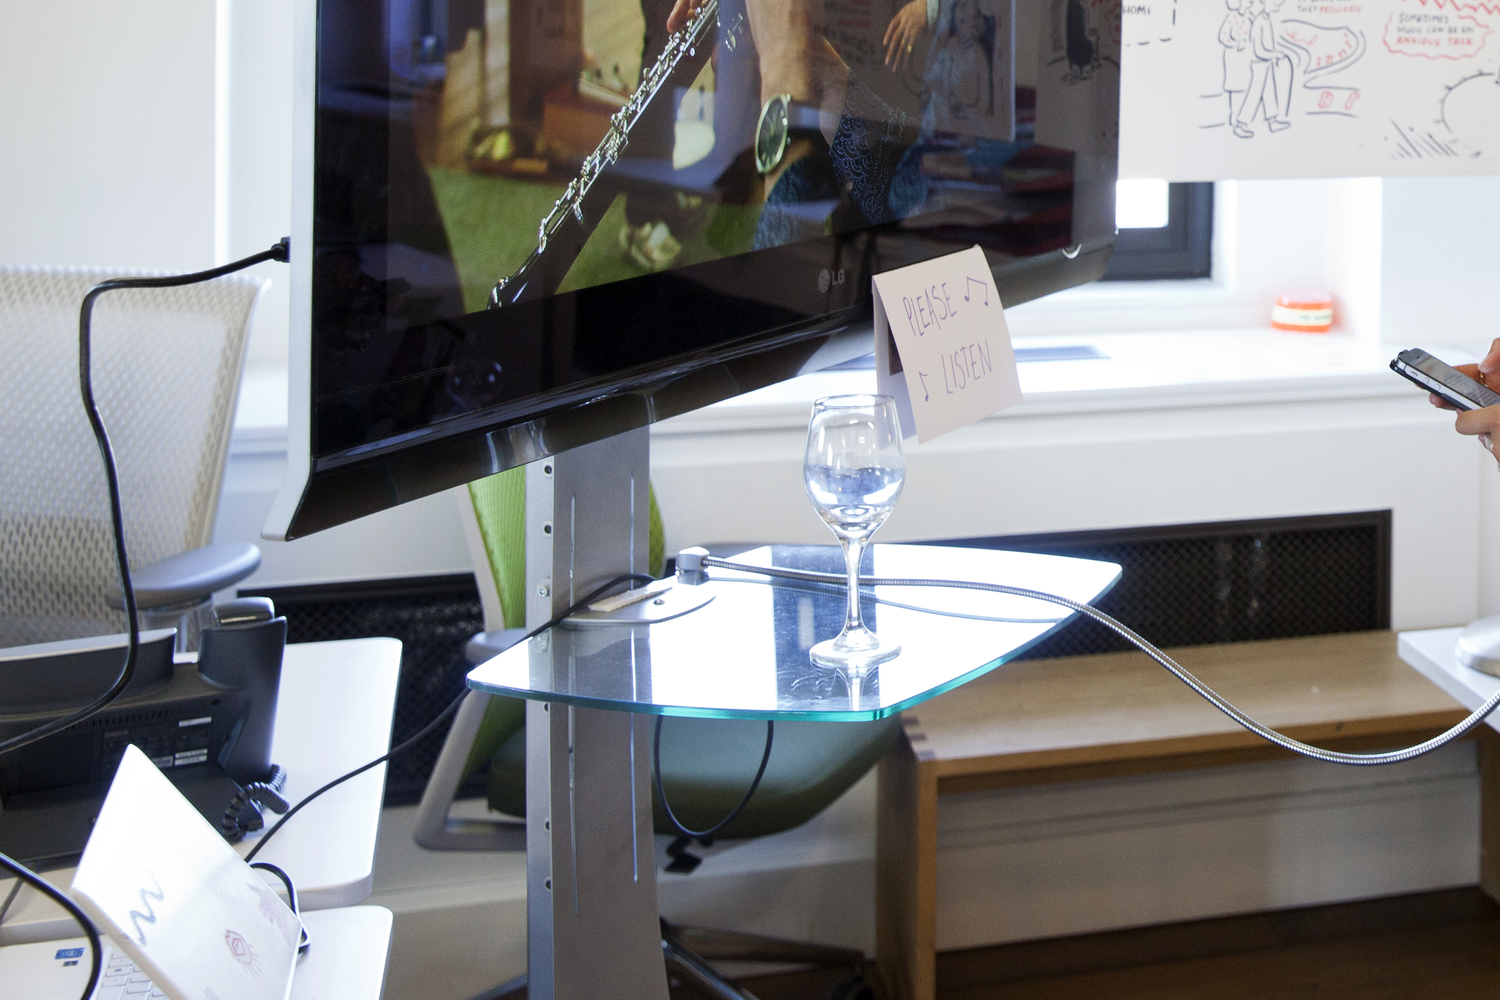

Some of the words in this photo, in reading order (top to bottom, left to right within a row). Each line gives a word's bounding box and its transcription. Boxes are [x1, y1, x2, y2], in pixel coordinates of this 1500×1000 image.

[832, 269, 845, 285] LG
[902, 281, 958, 337] PLEASE
[941, 339, 993, 395] LISTEN
